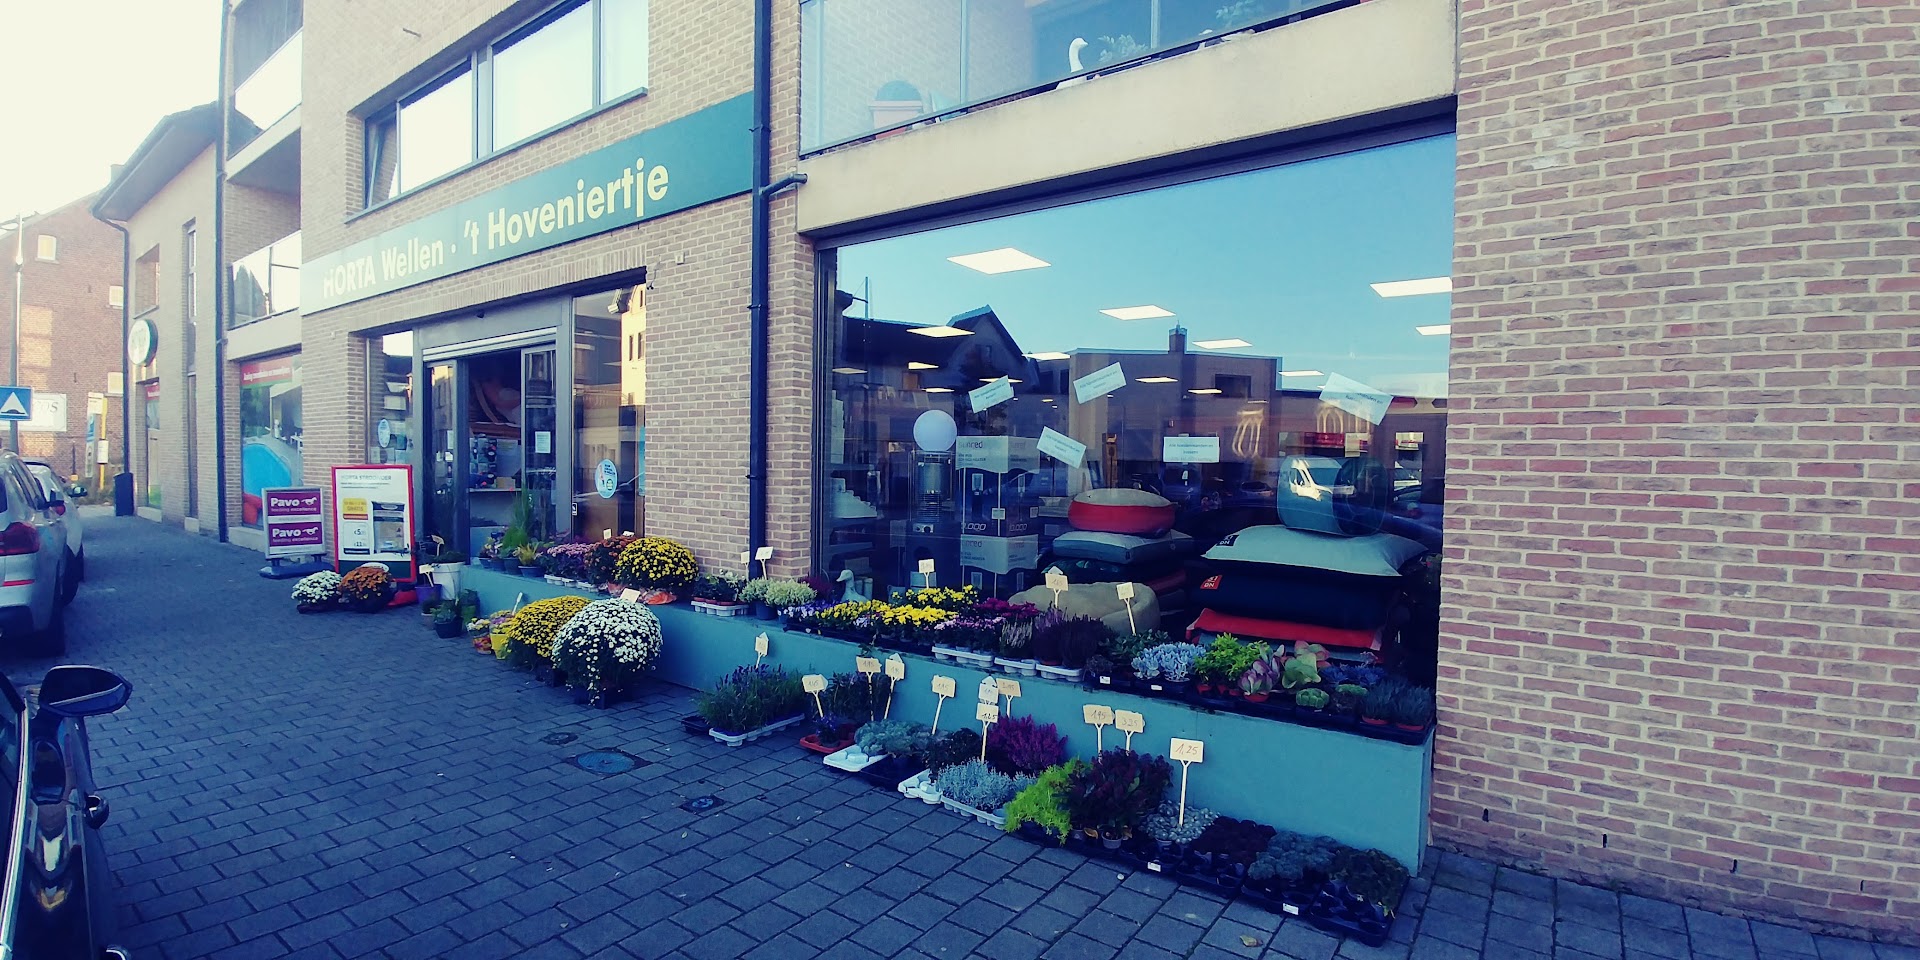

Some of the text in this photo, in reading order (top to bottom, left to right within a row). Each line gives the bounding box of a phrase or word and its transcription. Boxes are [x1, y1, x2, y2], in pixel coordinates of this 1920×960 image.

[323, 255, 377, 298] HORTA
[381, 237, 444, 282] Wellen
[488, 157, 669, 250] Hoveniertje
[270, 497, 300, 507] Pavo
[272, 528, 302, 538] Pavo
[1175, 744, 1199, 756] 1,25
